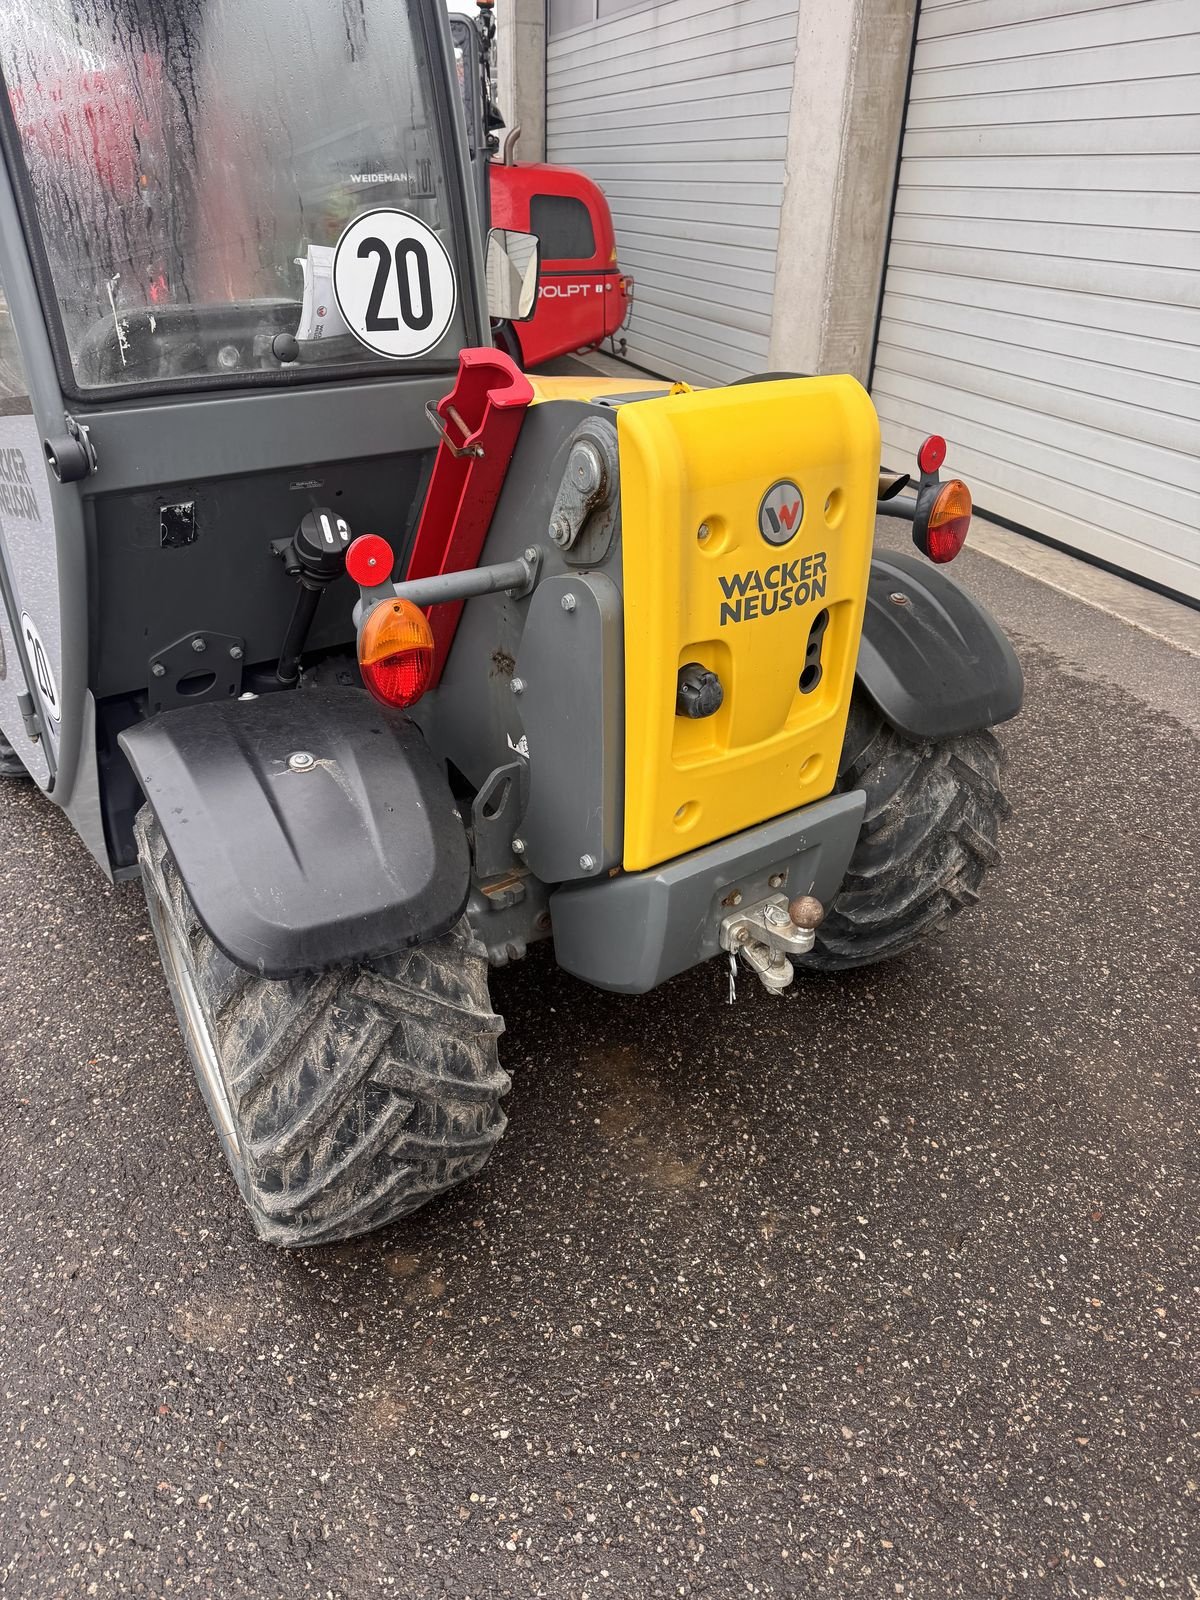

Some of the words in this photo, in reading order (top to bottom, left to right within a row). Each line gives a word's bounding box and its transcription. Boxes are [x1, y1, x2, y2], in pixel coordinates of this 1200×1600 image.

[357, 236, 433, 332] 20
[0, 448, 32, 485] CKER
[718, 551, 828, 600] WACKER
[719, 574, 827, 627] NEUSON
[26, 628, 56, 706] 20
